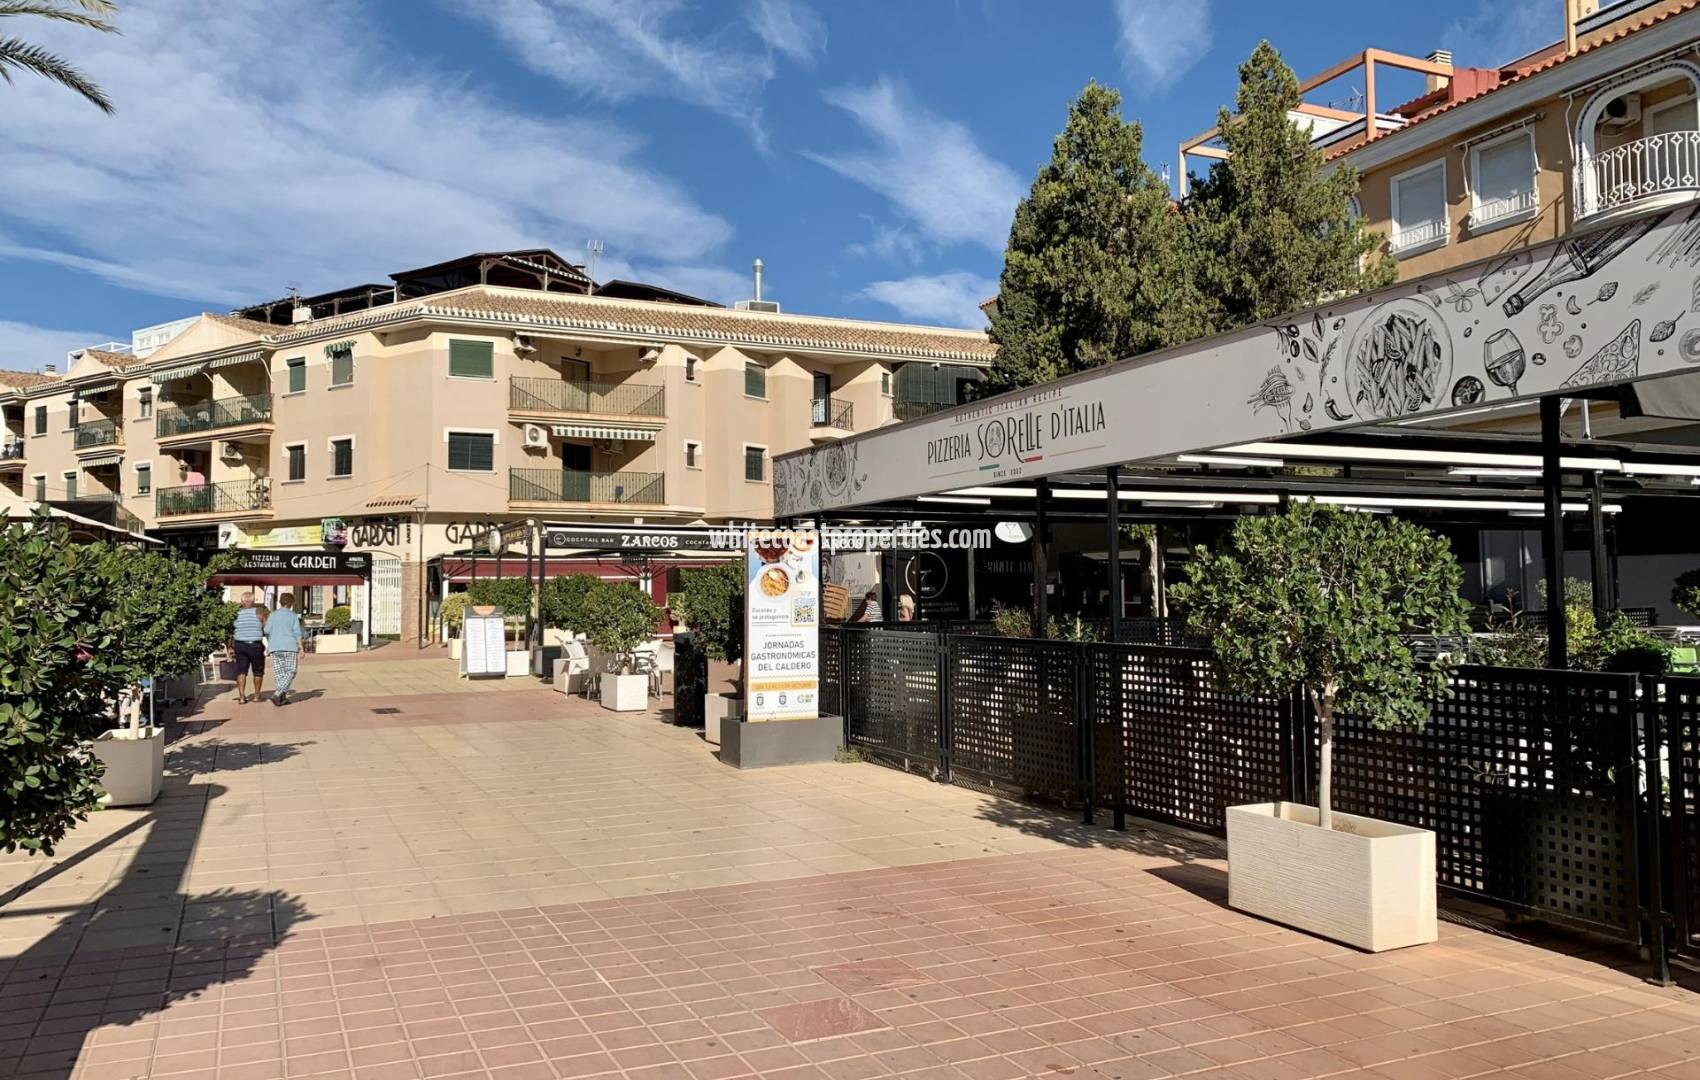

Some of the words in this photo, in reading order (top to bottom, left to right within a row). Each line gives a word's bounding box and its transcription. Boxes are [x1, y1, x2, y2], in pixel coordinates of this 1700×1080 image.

[955, 405, 992, 422] AUTHENTIC
[997, 397, 1028, 412] ITALIAN
[1033, 387, 1062, 403] RECIPE
[927, 432, 971, 465] PIZZERIA
[978, 412, 1043, 463] SORELLE
[1051, 401, 1106, 440] D'ITALIA
[621, 535, 679, 548] ZARCOS
[290, 555, 337, 569] GARDEN
[762, 640, 805, 650] JORNADAS
[758, 663, 774, 671] DEL
[775, 661, 812, 671] CALDERO
